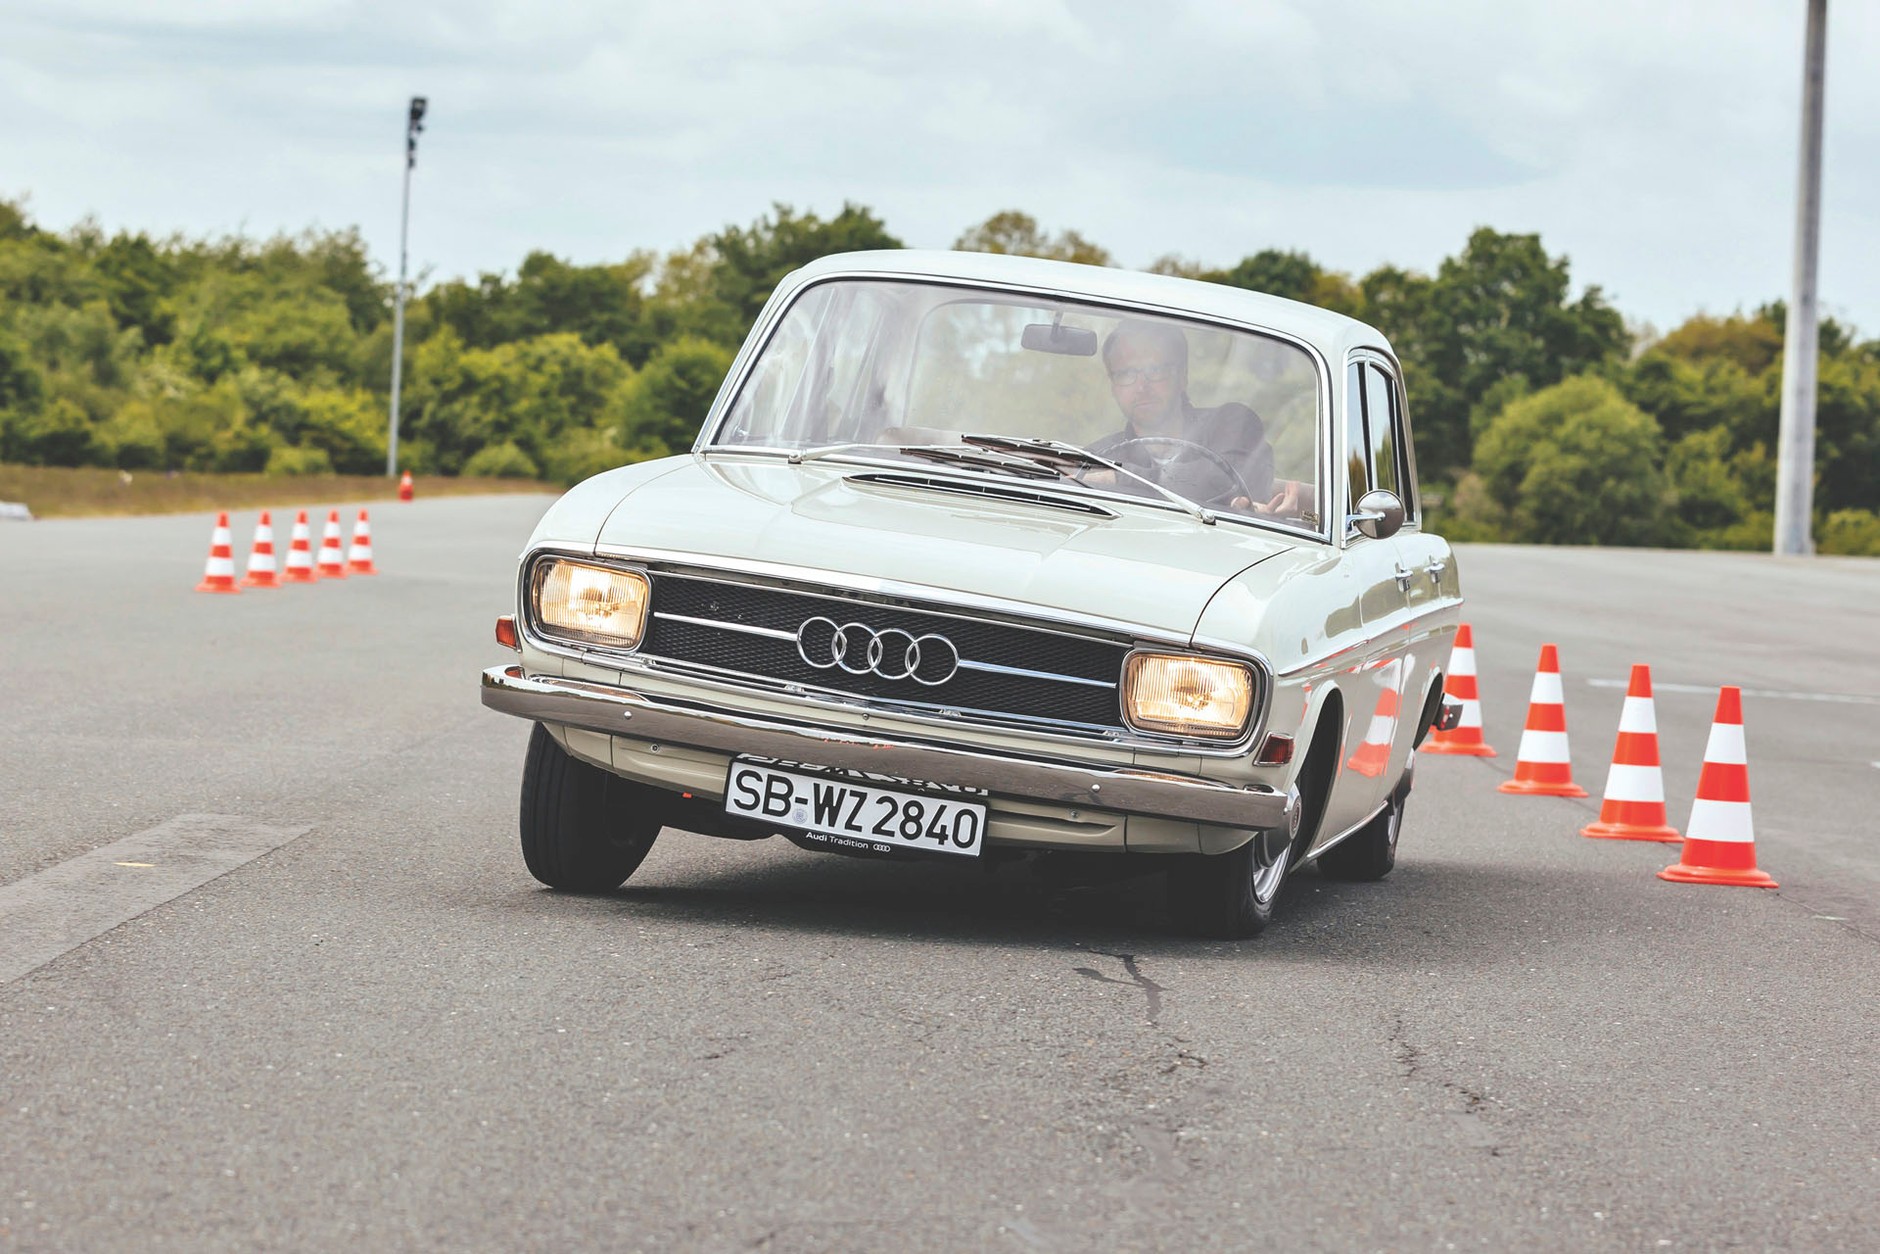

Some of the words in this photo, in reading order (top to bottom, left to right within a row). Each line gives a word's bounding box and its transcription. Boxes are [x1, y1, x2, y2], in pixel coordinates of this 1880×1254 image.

[733, 769, 868, 833] SB-WZ
[872, 795, 979, 849] 2840
[806, 831, 828, 842] Audi
[829, 835, 869, 849] Tradition
